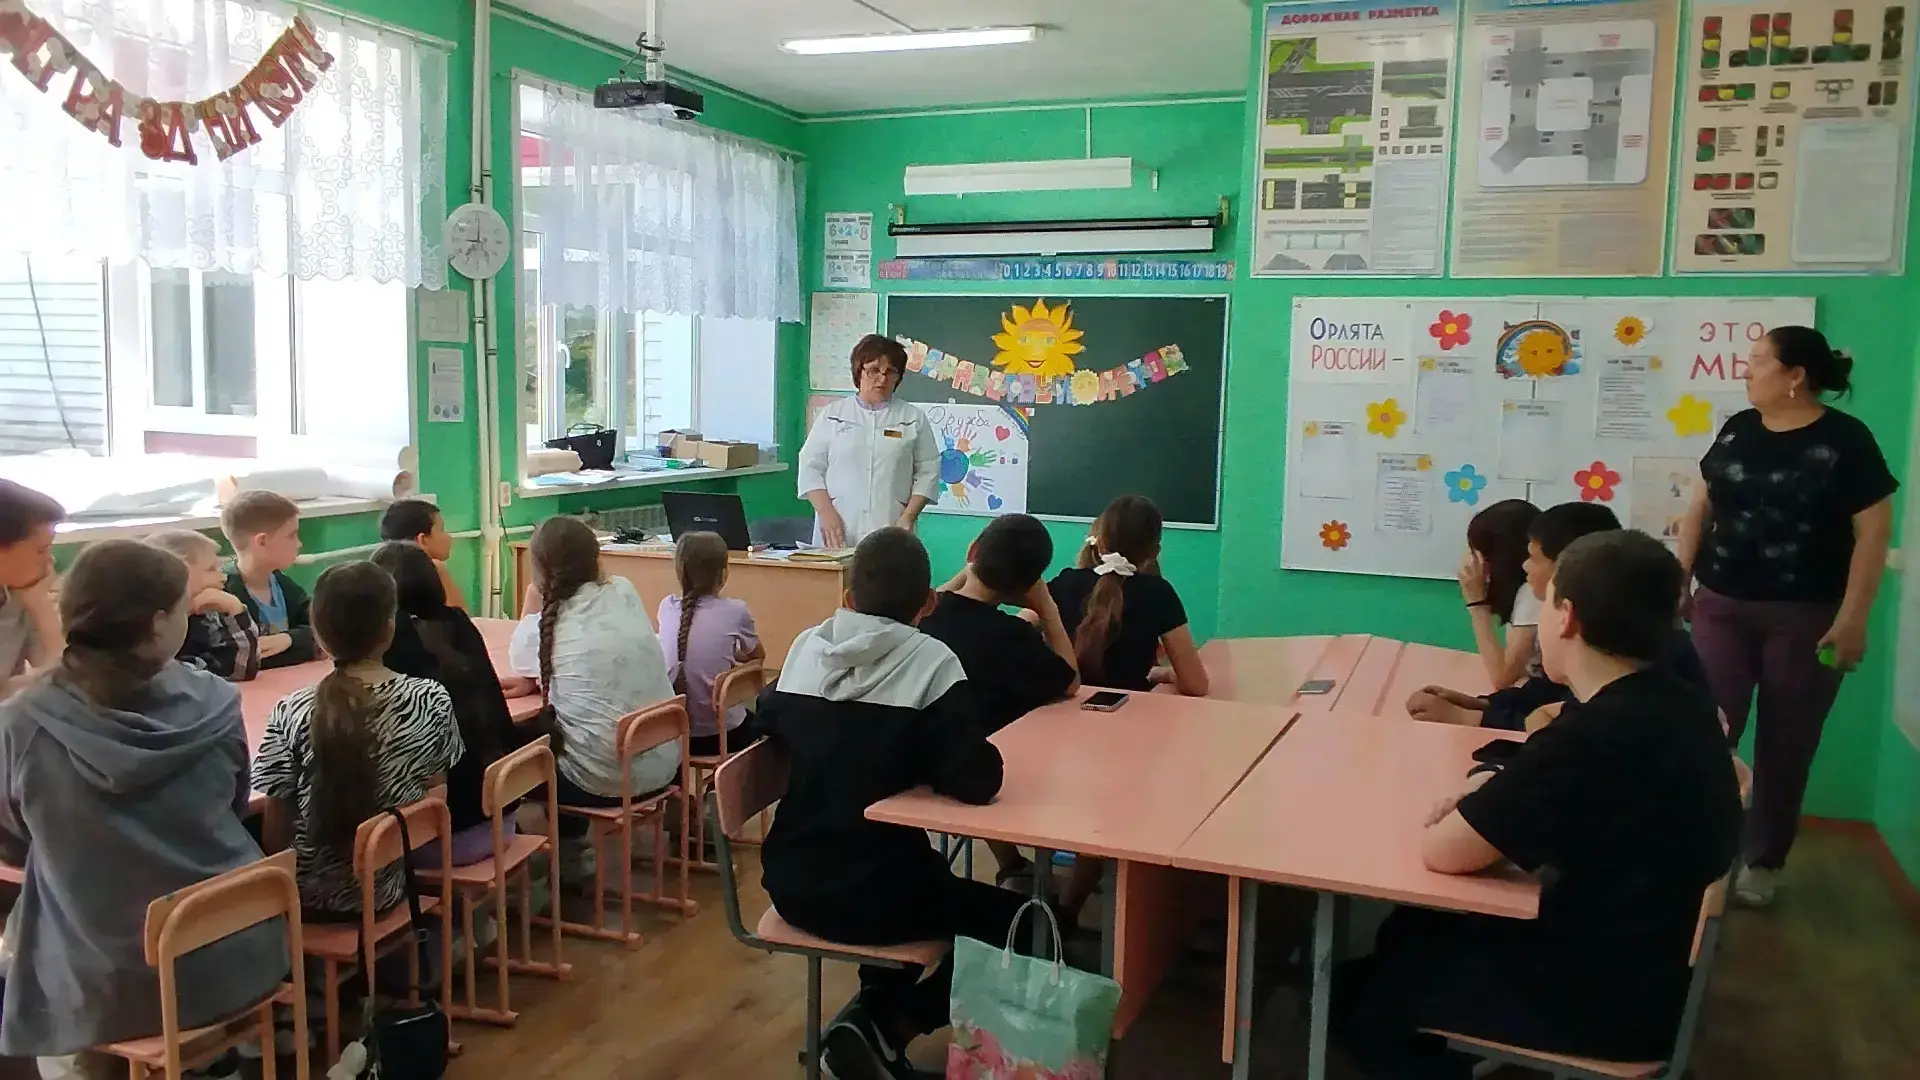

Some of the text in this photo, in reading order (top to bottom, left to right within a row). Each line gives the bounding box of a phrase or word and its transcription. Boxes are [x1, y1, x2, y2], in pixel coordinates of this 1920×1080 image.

[1281, 6, 1440, 25] ДОРОЖНАЯ РАЗМЕТКА
[1003, 263, 1011, 277] 0
[1014, 263, 1019, 277] 1
[1023, 263, 1031, 277] 2
[1034, 263, 1041, 277] 3
[1043, 263, 1052, 277] 4
[1054, 263, 1062, 277] 5
[1065, 263, 1072, 277] 6
[1076, 263, 1083, 277] 7
[1086, 263, 1093, 277] 8
[1097, 263, 1104, 277] 9
[1107, 263, 1117, 277] 10
[1118, 263, 1128, 277] 11
[1131, 263, 1141, 277] 12
[1144, 263, 1153, 277] 13
[1155, 263, 1165, 277] 14
[1168, 263, 1178, 278] 15
[1180, 263, 1191, 278] 16
[1192, 263, 1203, 278] 17
[1204, 263, 1215, 278] 18
[1216, 263, 1227, 278] 19
[1310, 317, 1384, 340] ОРЛЯТА
[1700, 322, 1764, 342] ЭТО
[1312, 344, 1386, 370] РОССИИ
